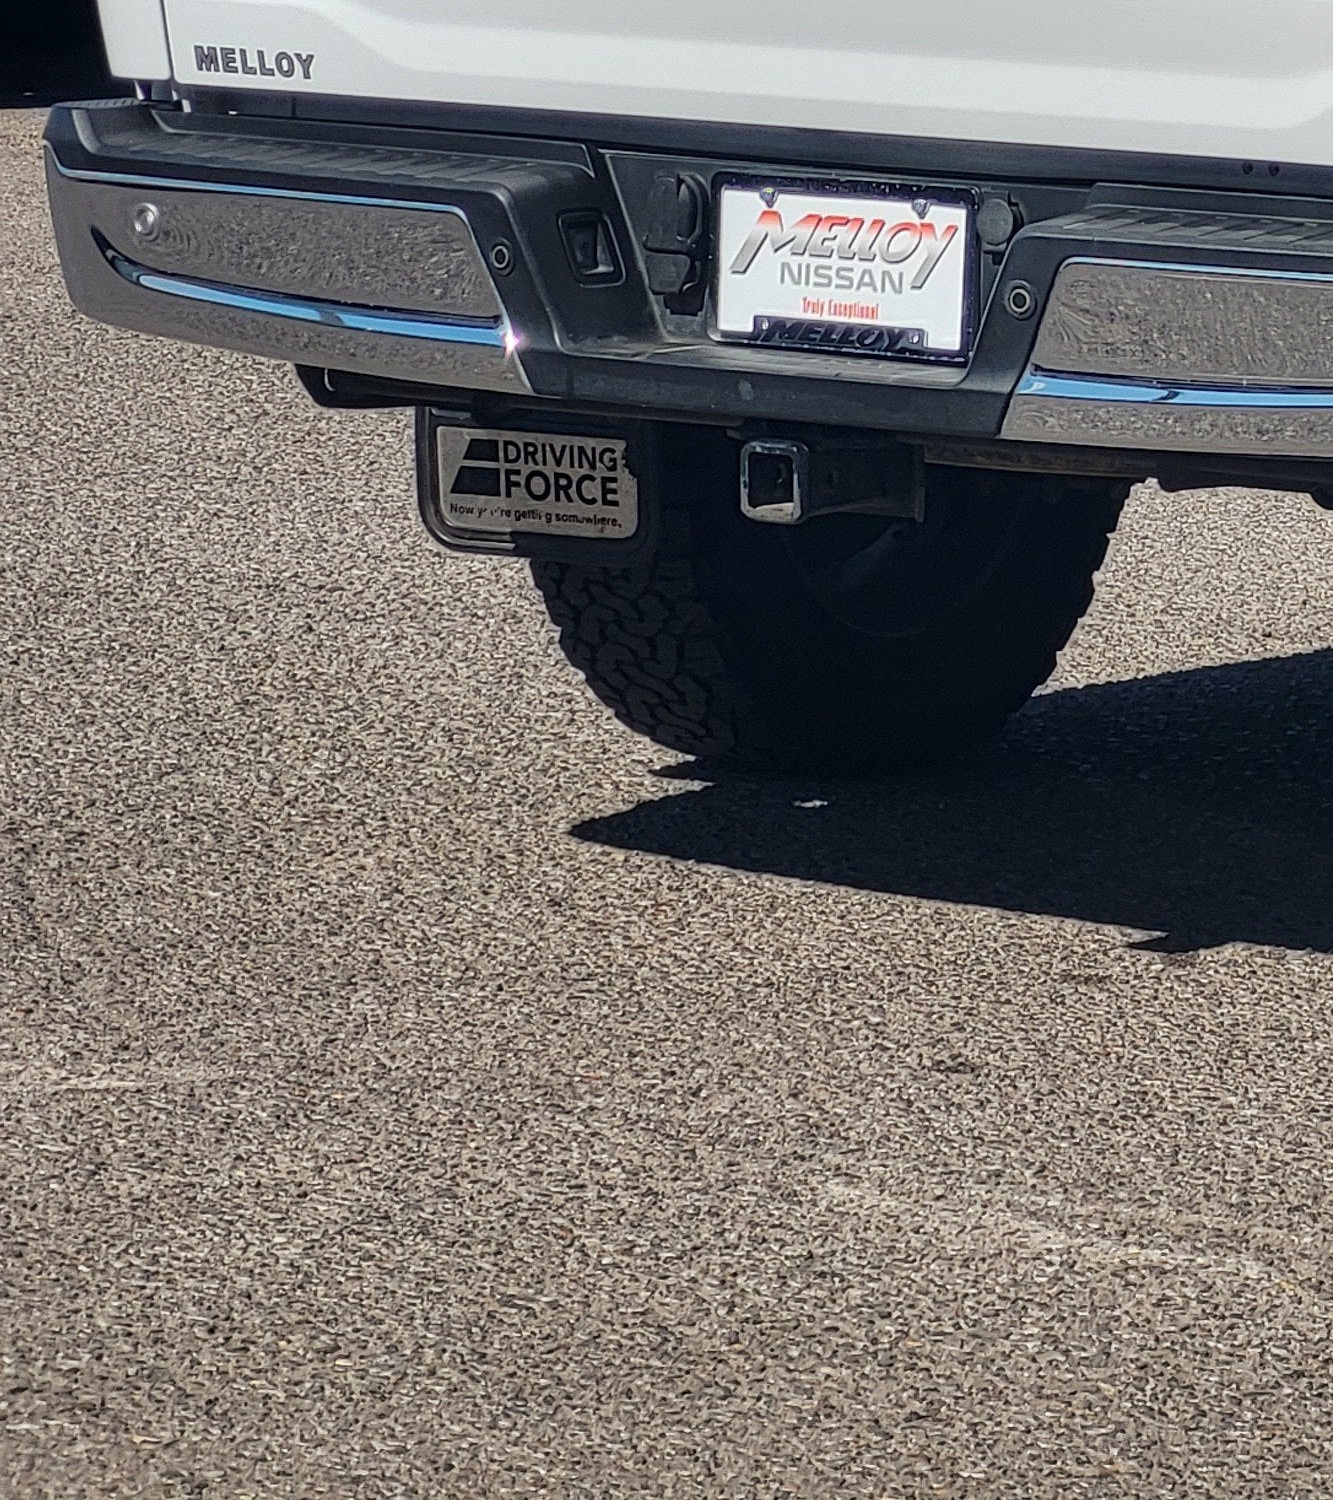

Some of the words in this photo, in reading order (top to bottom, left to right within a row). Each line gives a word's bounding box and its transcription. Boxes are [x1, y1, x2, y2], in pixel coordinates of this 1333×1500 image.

[194, 45, 315, 80] MELLOY
[730, 210, 958, 289] MELLOY
[780, 261, 904, 294] NISSAN
[802, 297, 825, 318] Truly
[828, 299, 880, 320] Exceptional
[760, 320, 906, 350] MELLOY
[503, 440, 618, 472] DRIVING
[504, 468, 620, 508] FORCE
[450, 502, 474, 515] Now
